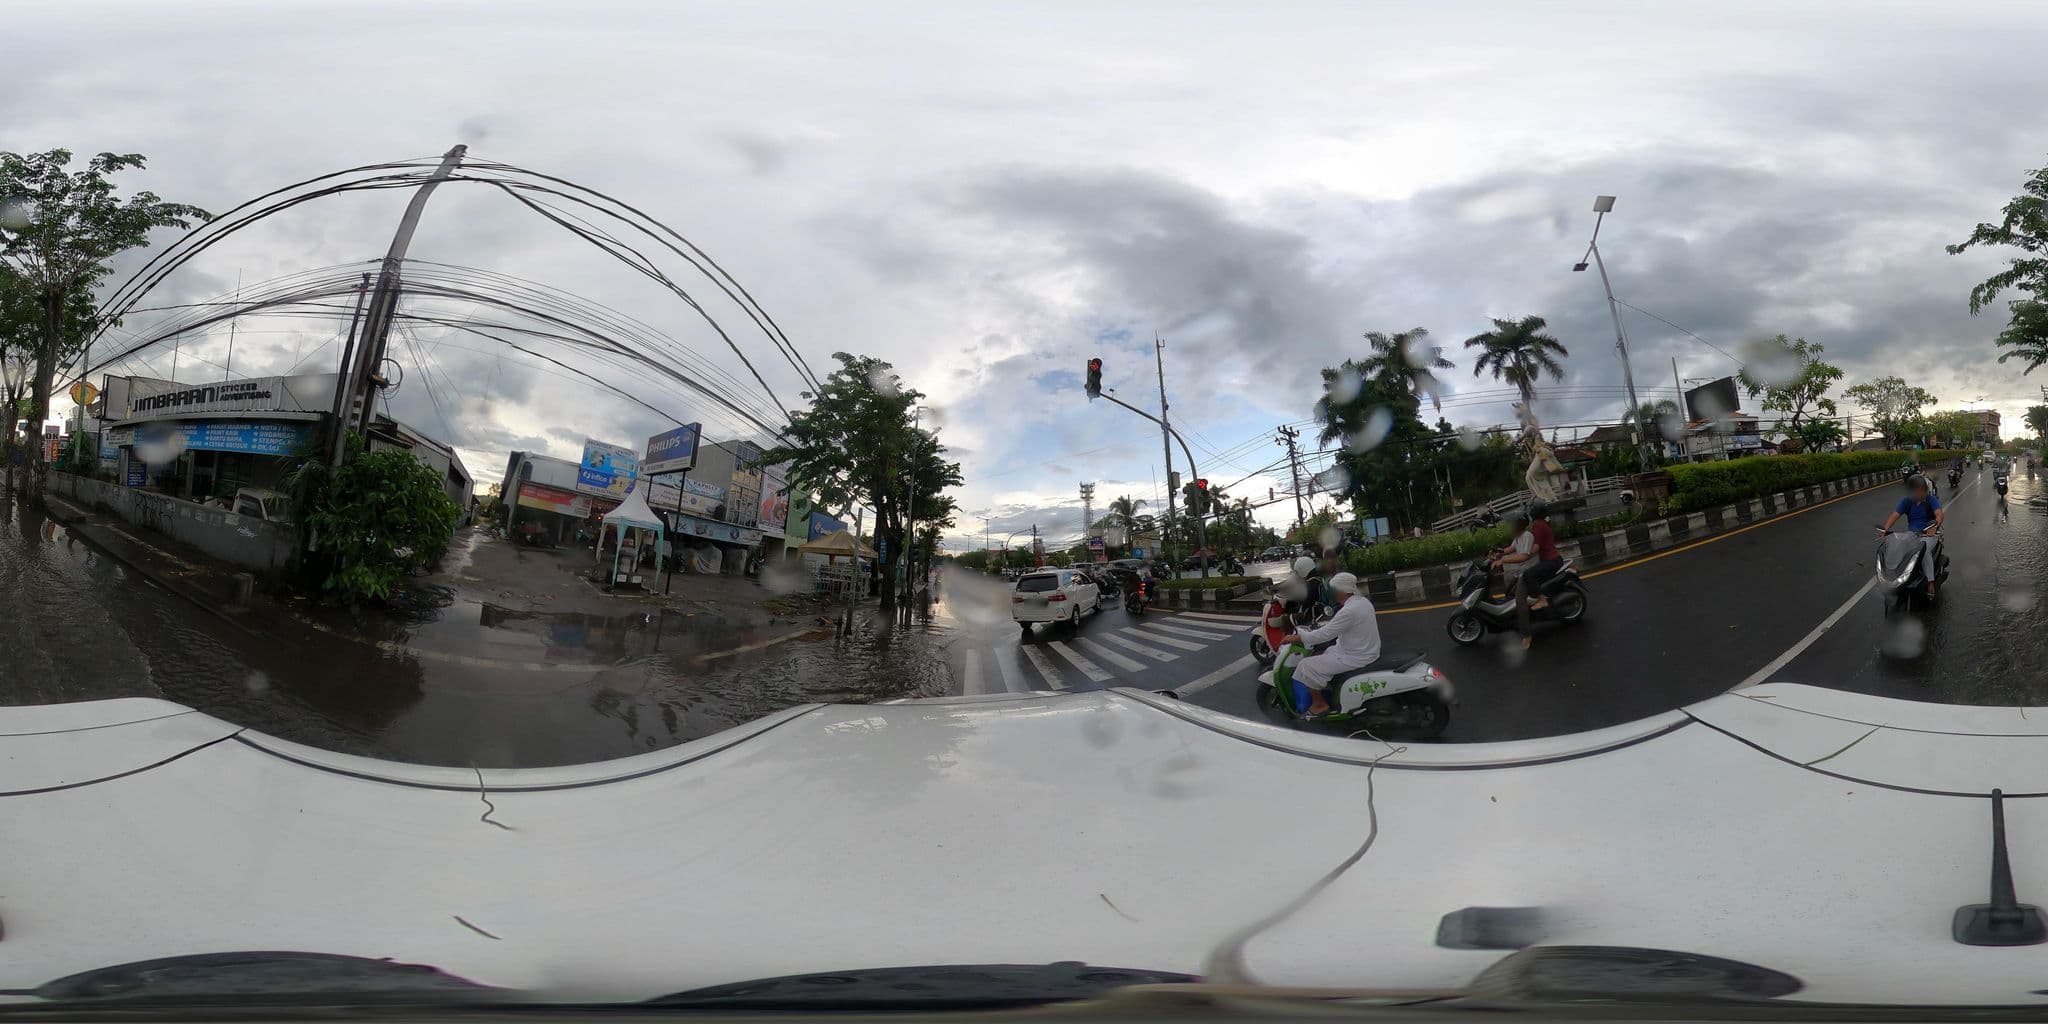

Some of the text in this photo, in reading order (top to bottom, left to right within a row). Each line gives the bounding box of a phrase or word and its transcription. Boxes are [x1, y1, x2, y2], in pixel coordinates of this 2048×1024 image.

[220, 383, 258, 393] STICKER
[132, 387, 215, 412] JIMBARAN
[219, 390, 272, 402] ADVERTISING
[649, 436, 681, 455] PHILIPS
